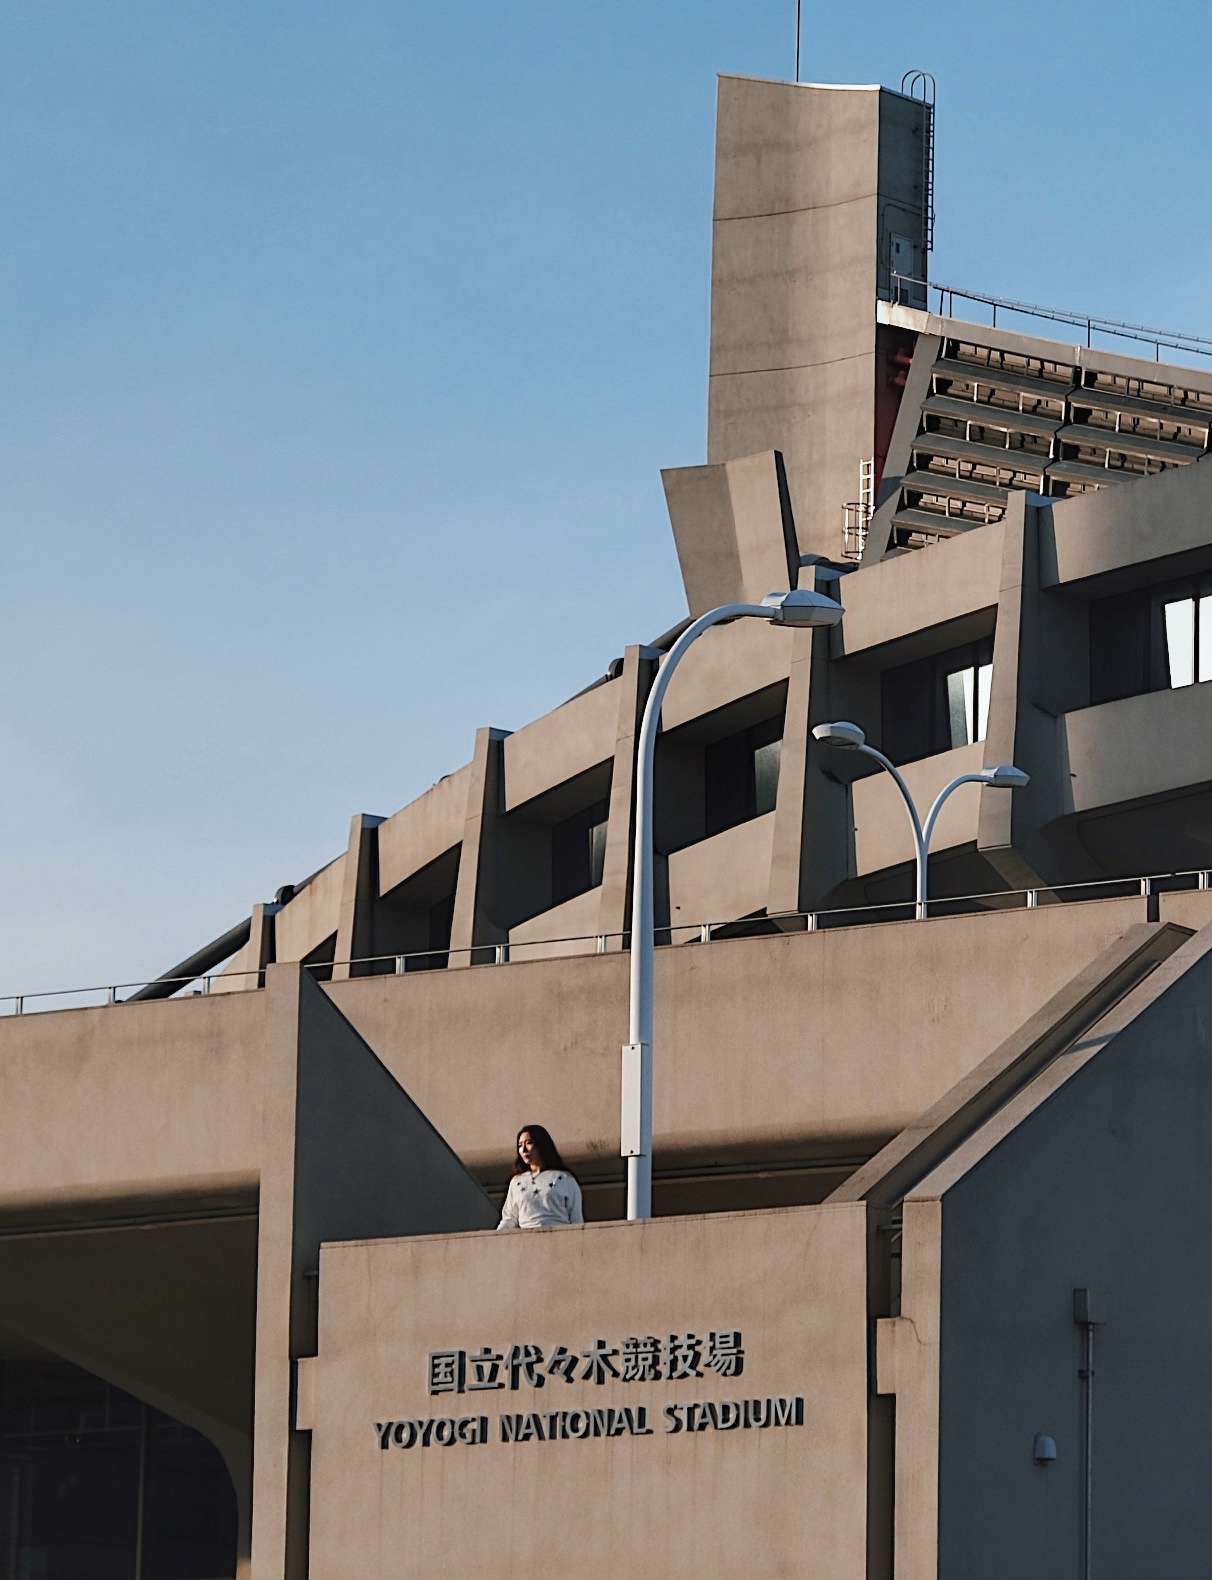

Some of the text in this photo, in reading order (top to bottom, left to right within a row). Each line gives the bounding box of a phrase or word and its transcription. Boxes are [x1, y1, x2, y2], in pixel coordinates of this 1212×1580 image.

[428, 1331, 744, 1395] 国立代々木競技場
[373, 1397, 804, 1449] YOYOGI NATIONAL STADIUM
